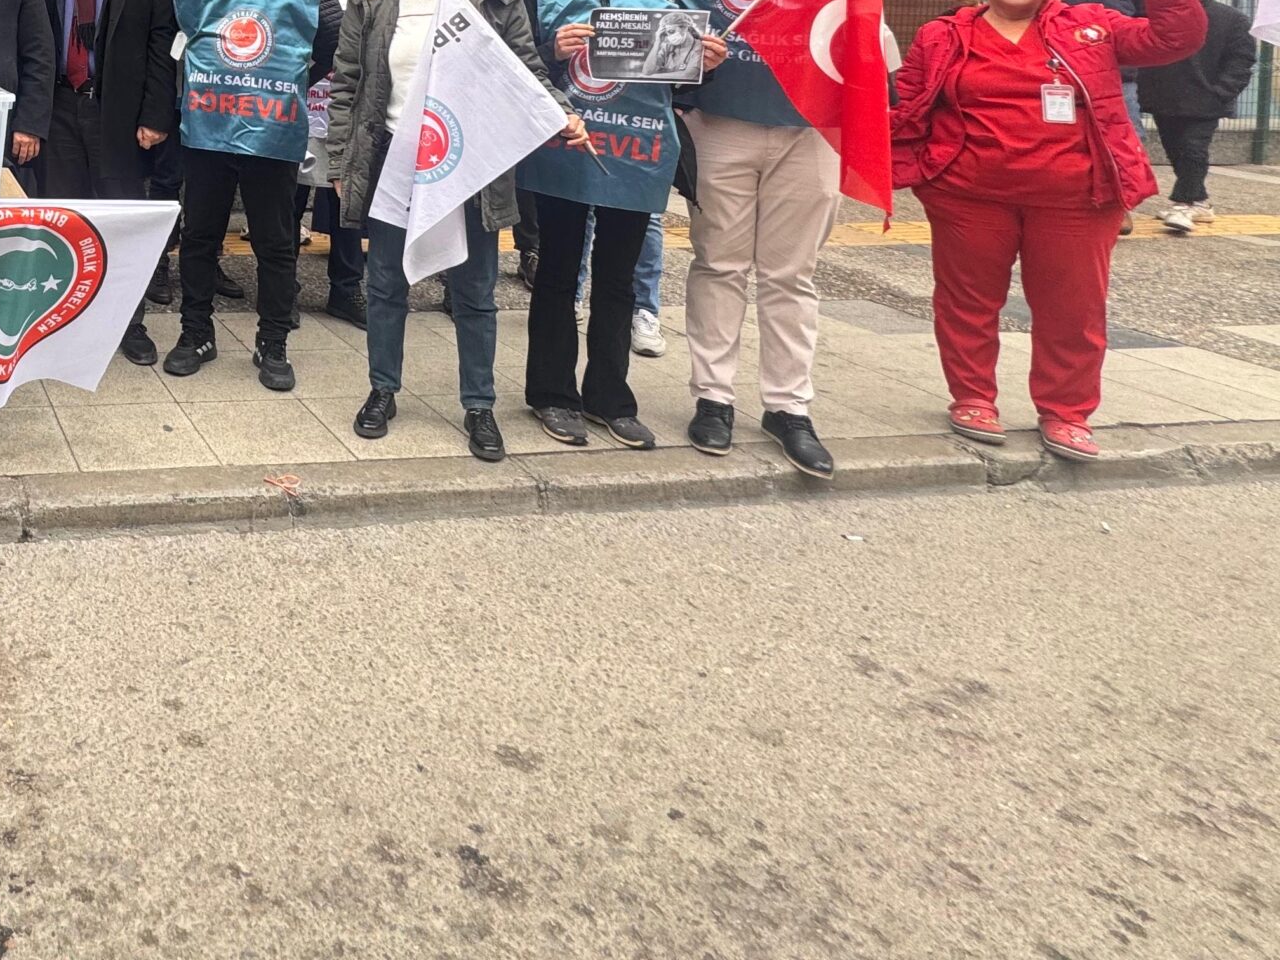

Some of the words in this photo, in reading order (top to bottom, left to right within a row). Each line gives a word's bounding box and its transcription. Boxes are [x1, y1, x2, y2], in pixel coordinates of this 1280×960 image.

[596, 21, 619, 29] FAZLA
[620, 21, 651, 30] MESAİSİ
[597, 37, 634, 49] 100,55
[224, 73, 272, 91] SAĞLIK
[274, 81, 298, 94] SEN
[632, 116, 664, 130] SEN
